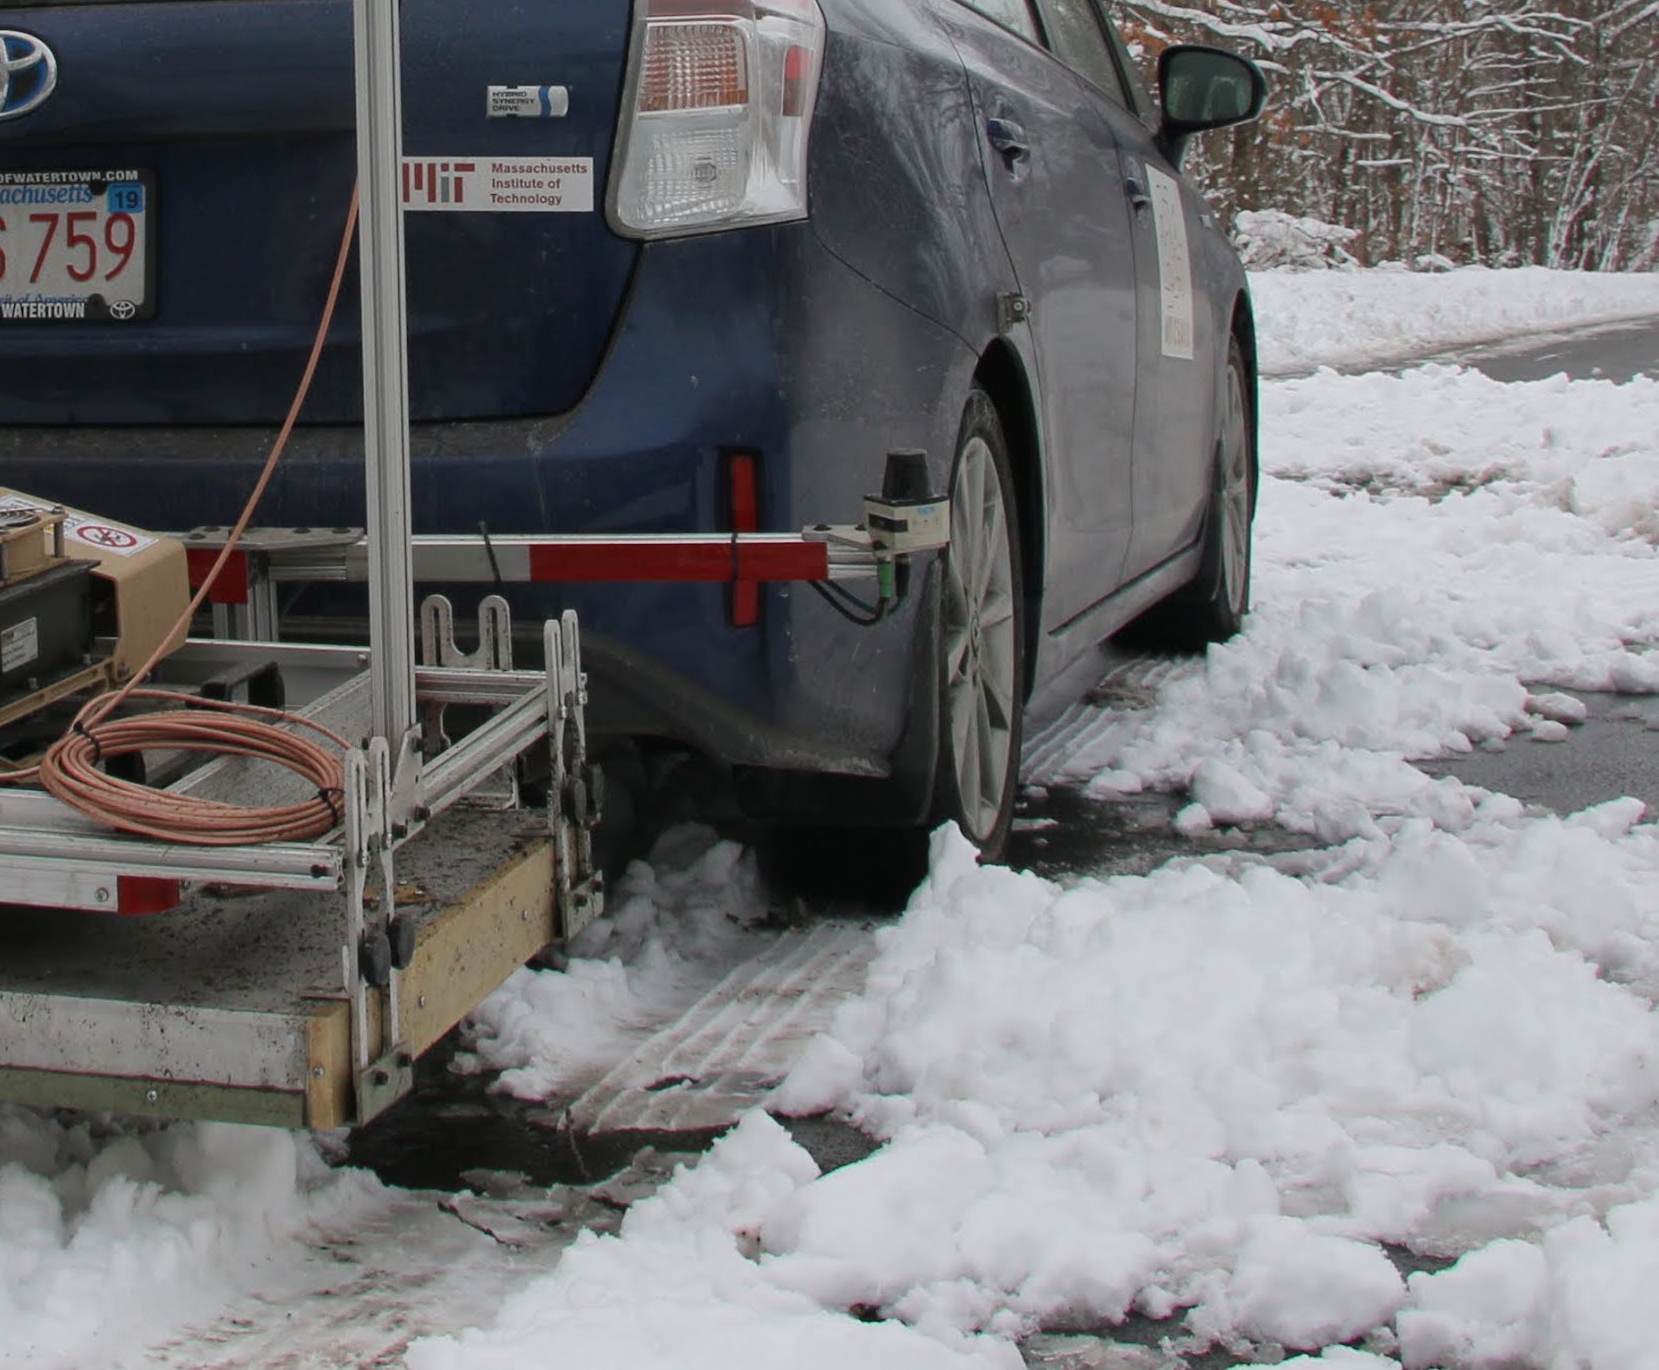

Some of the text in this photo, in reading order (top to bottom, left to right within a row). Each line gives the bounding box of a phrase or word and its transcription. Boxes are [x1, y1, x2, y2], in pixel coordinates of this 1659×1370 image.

[490, 162, 588, 175] Massachusetts
[402, 163, 475, 203] MIT
[490, 177, 561, 190] Institute of
[114, 190, 139, 210] 19
[489, 192, 563, 207] Technology
[28, 211, 137, 285] 759
[1, 302, 85, 319] WATERTOWN
